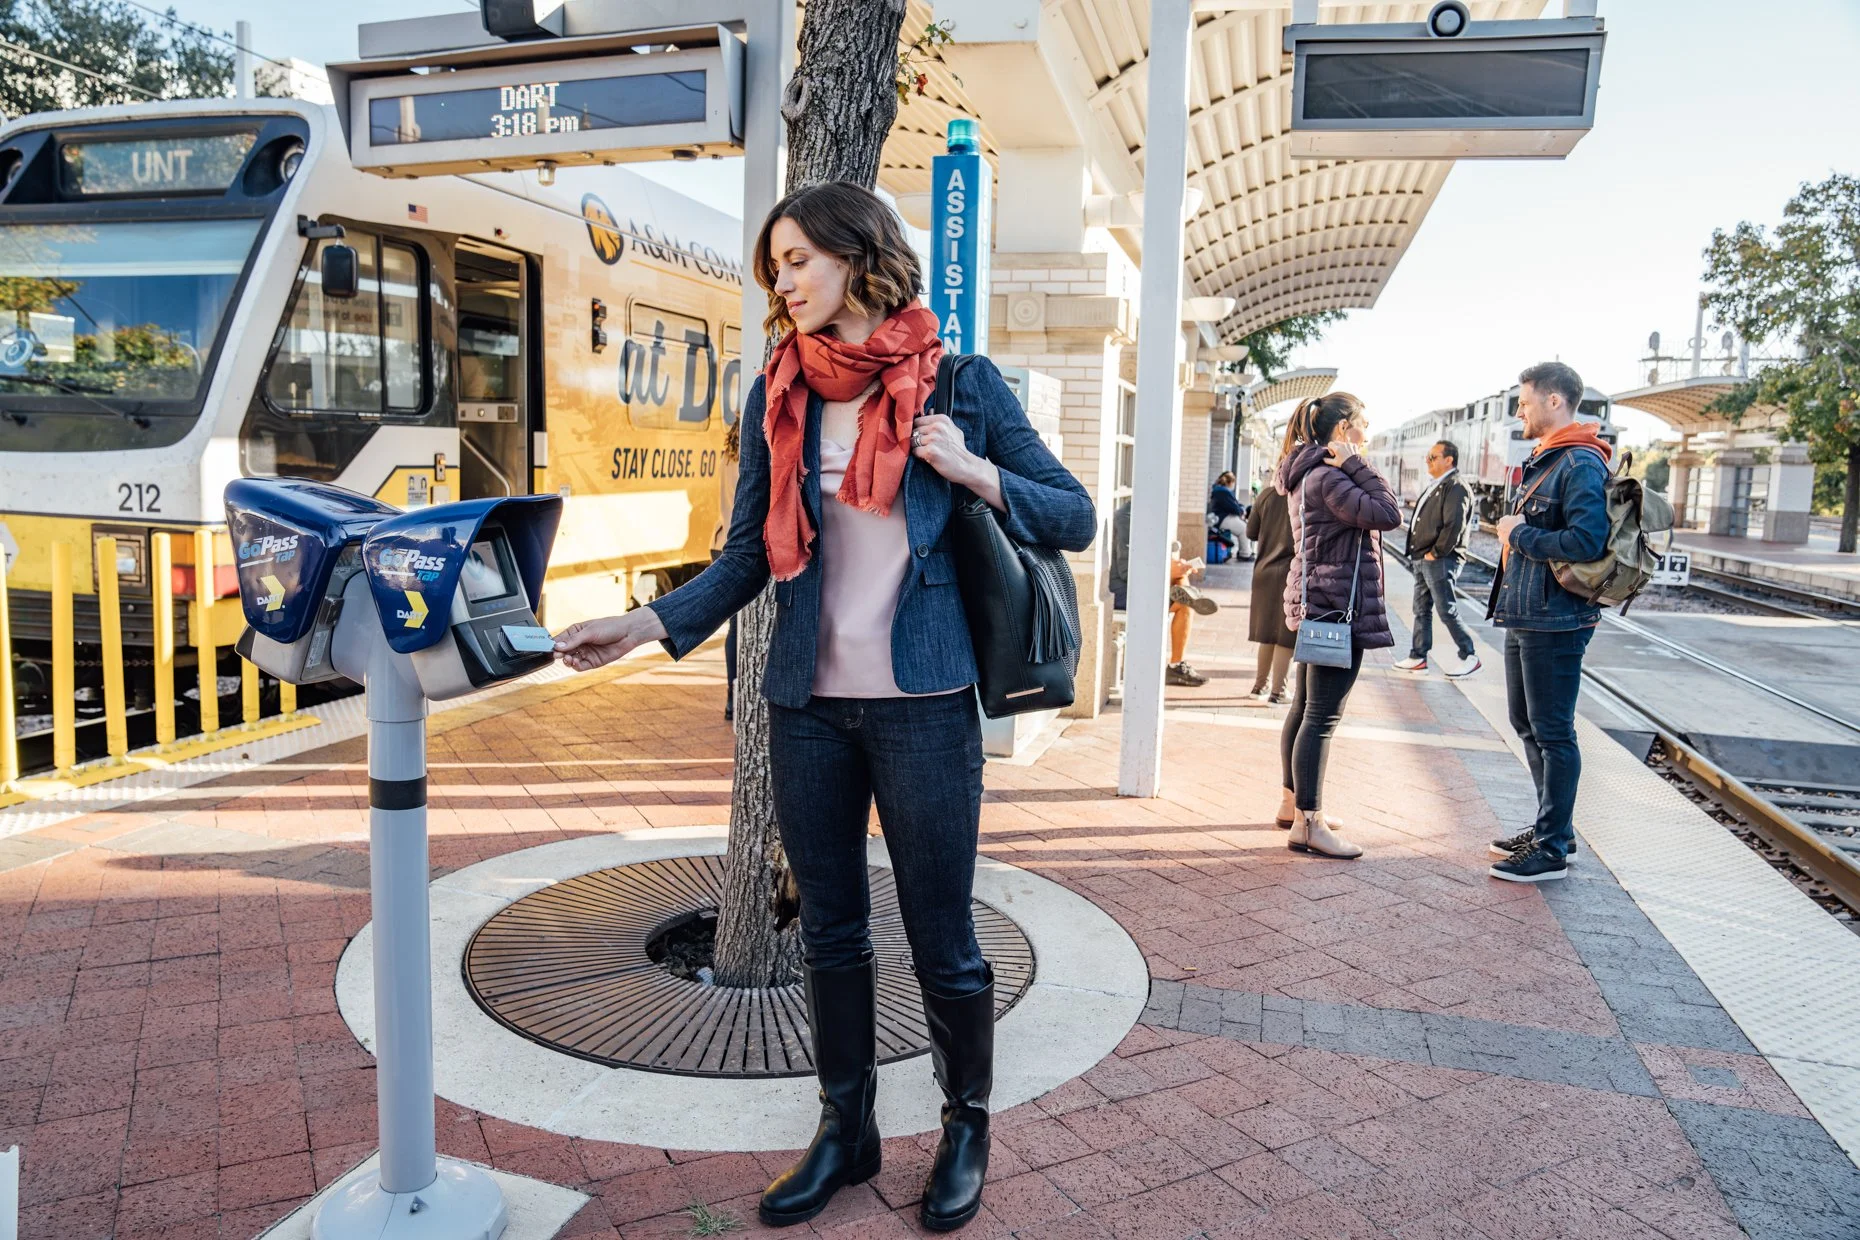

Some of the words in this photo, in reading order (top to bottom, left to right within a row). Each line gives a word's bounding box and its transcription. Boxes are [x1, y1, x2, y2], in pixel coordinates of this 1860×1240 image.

[500, 82, 560, 111] DART
[490, 111, 537, 138] 3:18
[544, 116, 579, 134] pm
[131, 149, 193, 183] UNT
[629, 217, 689, 270] A&M
[943, 168, 966, 355] ASSISTAN
[618, 319, 670, 407] at
[612, 447, 648, 480] STAY
[651, 448, 695, 479] CLOSE.
[700, 450, 717, 478] GO
[118, 482, 161, 513] 212
[238, 534, 299, 560] GoPass
[379, 548, 447, 571] GoPass
[256, 593, 282, 607] DART
[396, 609, 424, 620] DART
